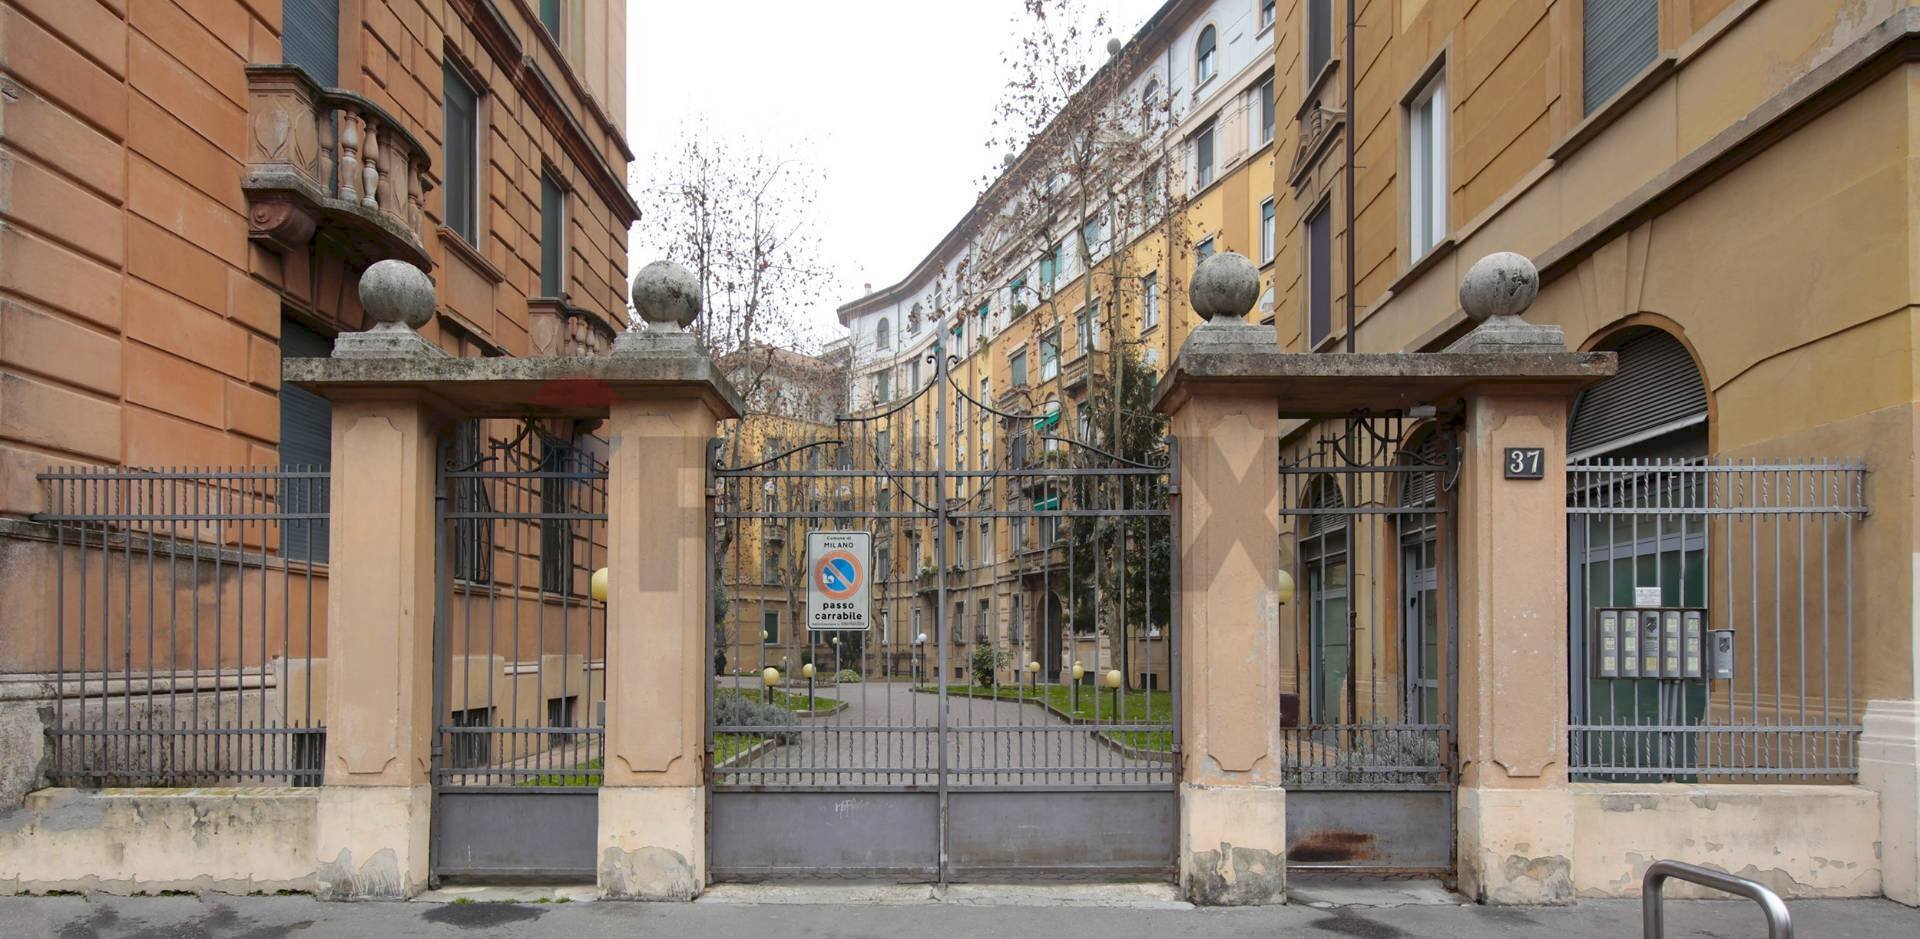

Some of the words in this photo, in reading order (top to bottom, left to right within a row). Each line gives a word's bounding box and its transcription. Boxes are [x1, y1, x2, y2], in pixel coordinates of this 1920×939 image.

[1511, 450, 1540, 473] 37
[823, 602, 854, 610] passo
[815, 611, 862, 620] carrabile
